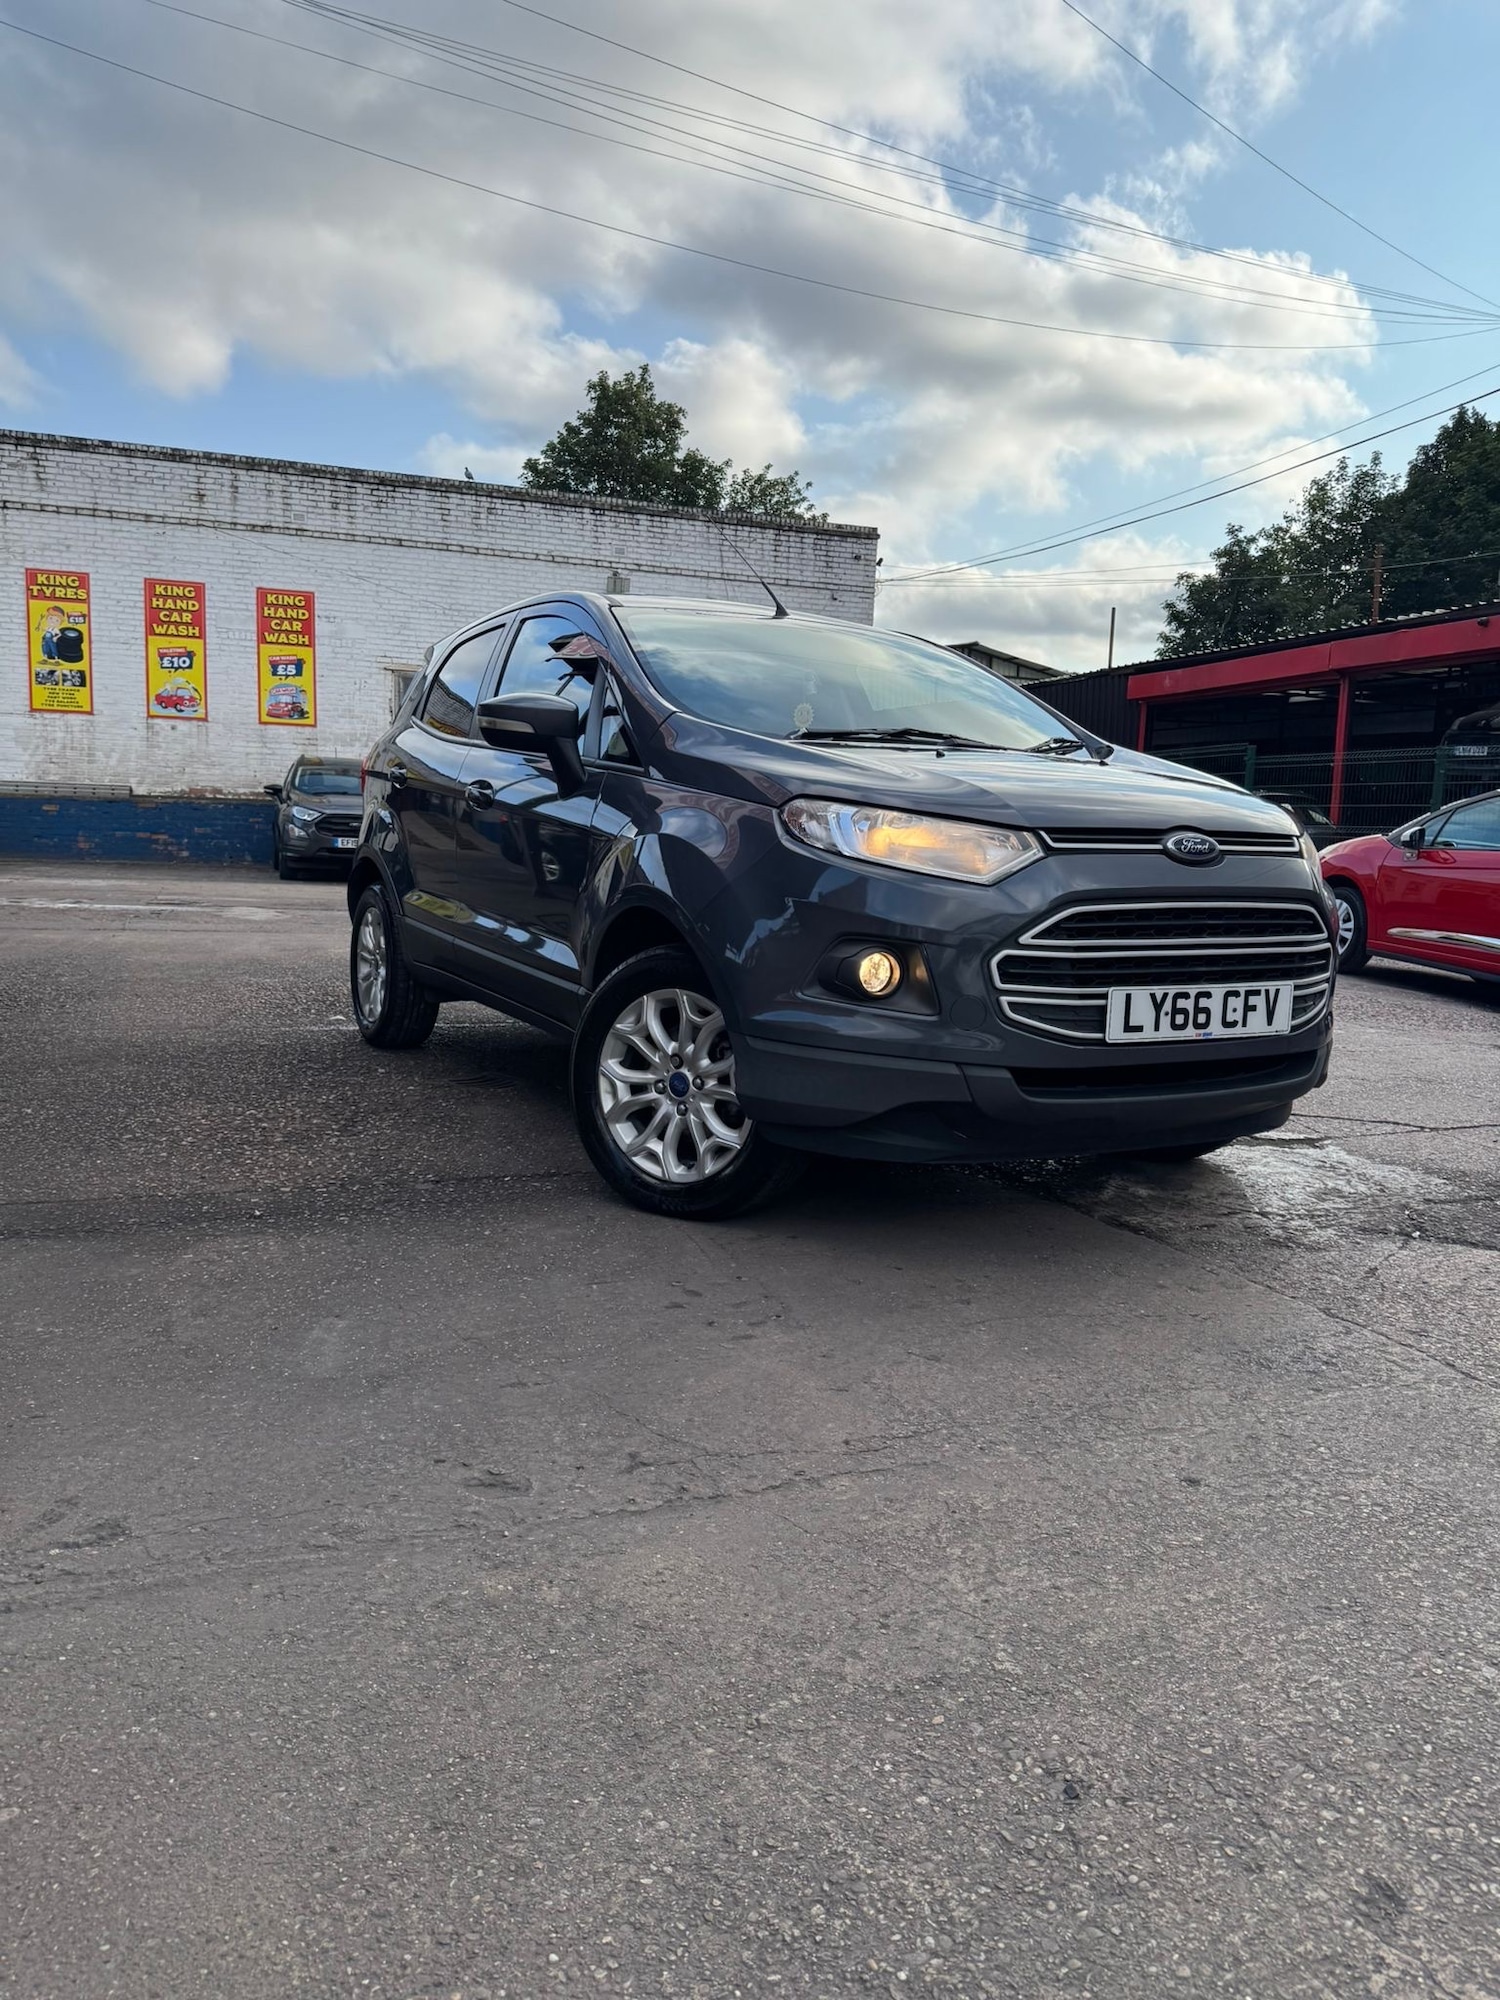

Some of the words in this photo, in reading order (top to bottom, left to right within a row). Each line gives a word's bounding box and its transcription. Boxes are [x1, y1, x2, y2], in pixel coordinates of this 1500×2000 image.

[37, 573, 80, 586] KING
[29, 585, 88, 600] TYRES
[155, 584, 196, 598] KING
[151, 597, 200, 611] HAND
[266, 593, 306, 607] KING
[159, 611, 193, 624] CAR
[263, 606, 310, 619] HAND
[152, 623, 200, 637] WASH
[270, 620, 303, 632] CAR
[264, 632, 310, 645] WASH
[161, 656, 191, 668] £10
[276, 664, 297, 675] £5
[1180, 837, 1210, 853] Ford
[1122, 990, 1213, 1033] LY66
[1220, 987, 1281, 1029] CFV
